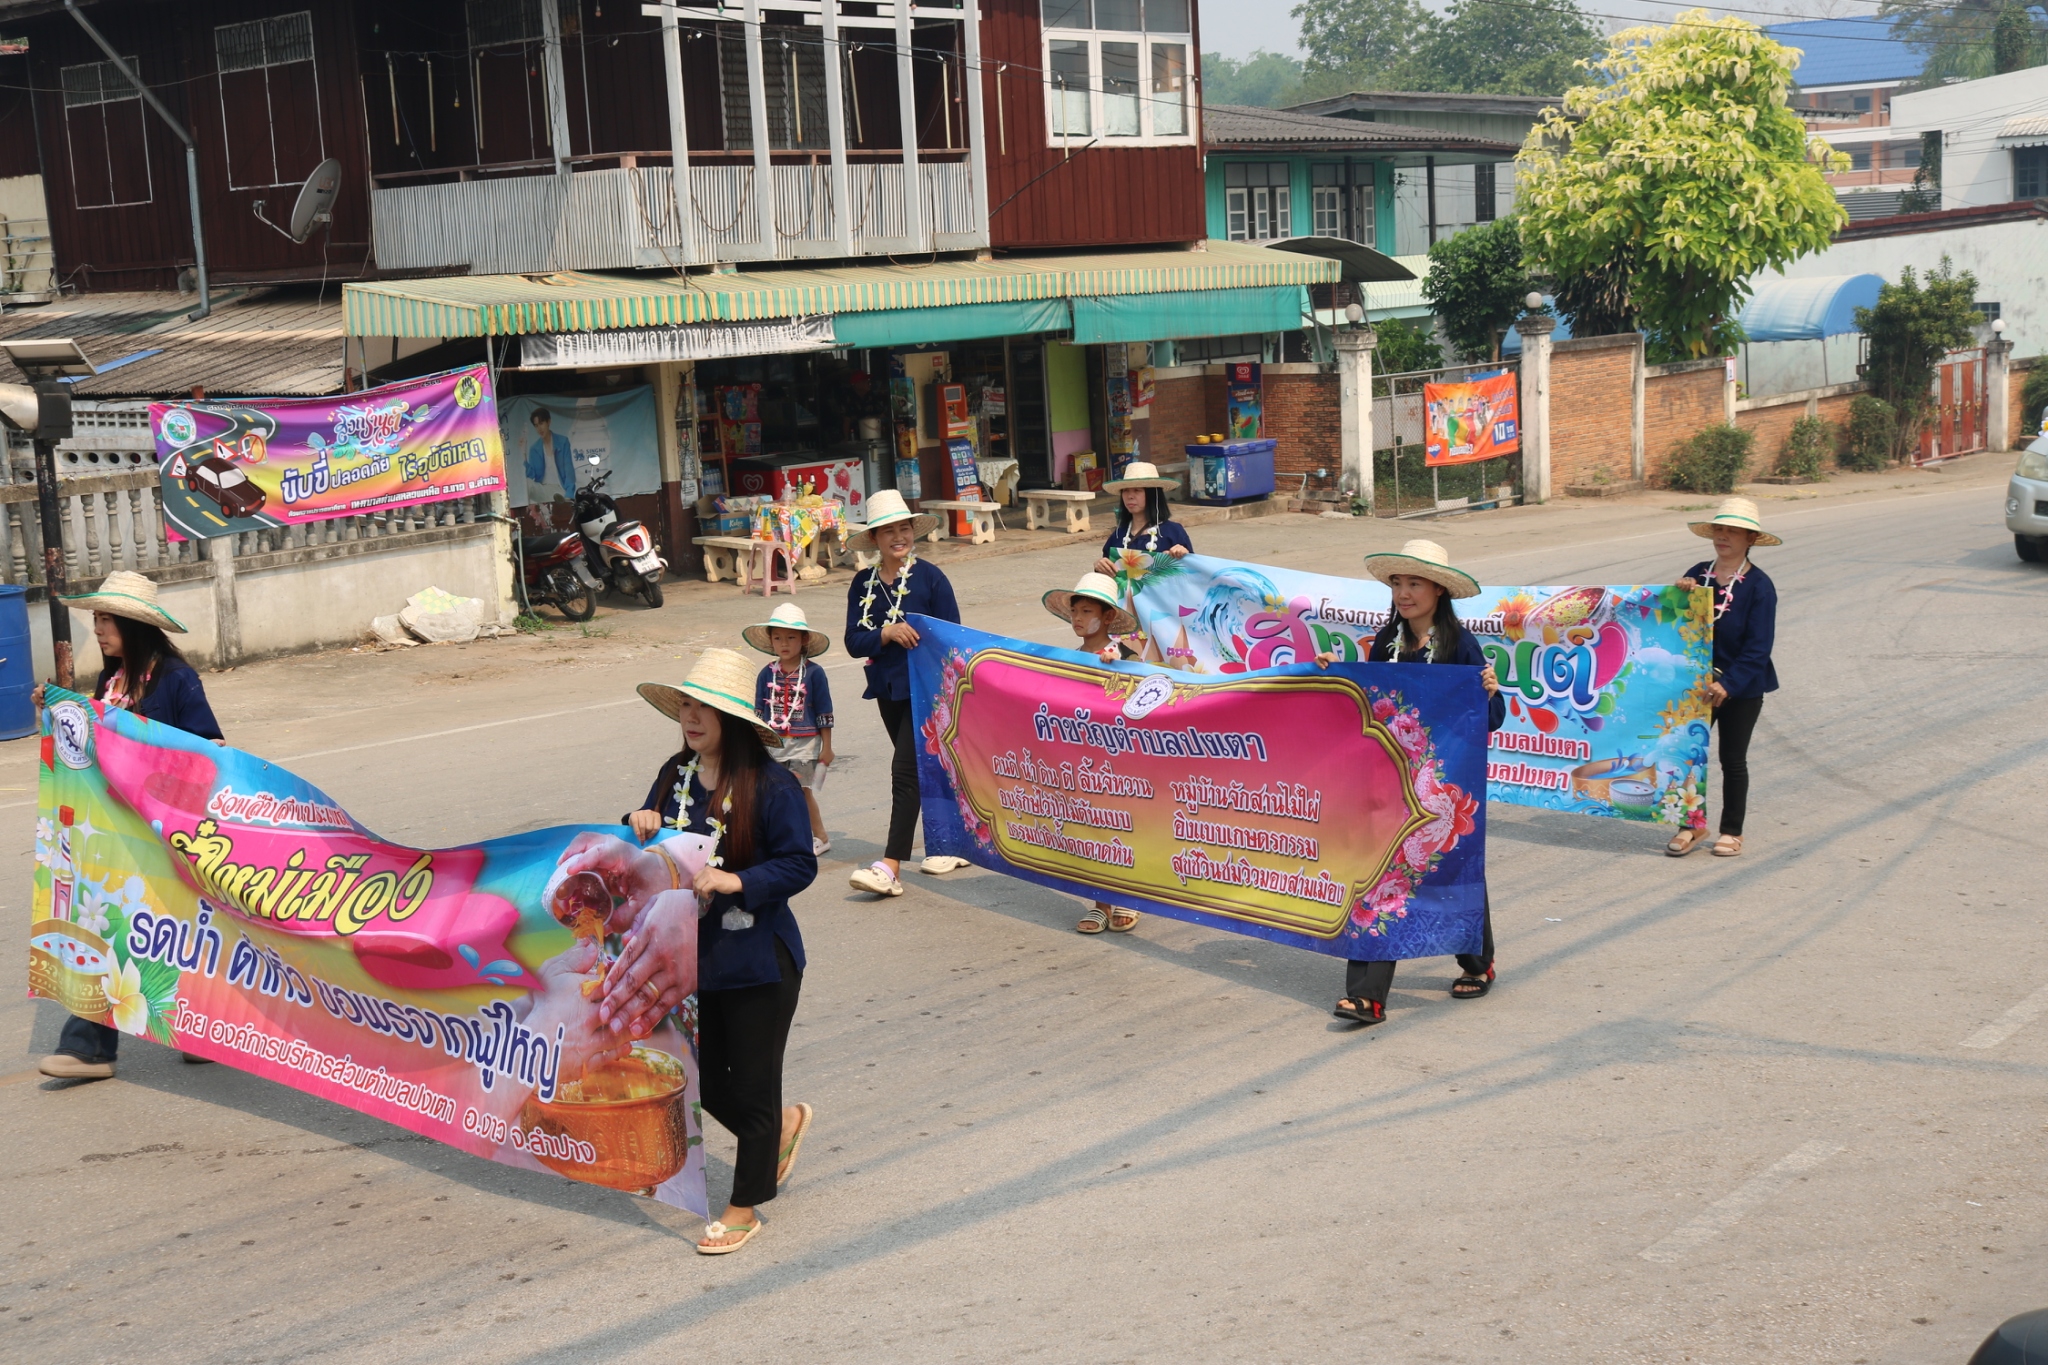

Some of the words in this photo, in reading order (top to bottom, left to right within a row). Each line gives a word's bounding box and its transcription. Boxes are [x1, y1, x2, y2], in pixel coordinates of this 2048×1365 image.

[334, 402, 409, 447] สงกรานต์
[281, 447, 330, 503] ขับขี่
[331, 455, 390, 489] ปลอดภัย
[399, 437, 487, 484] ไร้อุบัติเหตุ
[1034, 704, 1267, 760] คำขวัญตำบลปงเตา
[992, 752, 1019, 778] คนดี
[1020, 748, 1038, 782] น้ำ
[1038, 759, 1059, 787] ดิน
[1060, 761, 1075, 790] ดี
[1078, 756, 1153, 797] ลิ้นจี่หวาน
[1170, 775, 1321, 822] หมู่บ้านจักสานไม้ไผ่
[129, 899, 220, 975] รดน้ำ
[311, 976, 564, 1099] ขอพรจากผู้ใหญ่
[176, 1001, 206, 1035] โดย
[211, 1024, 455, 1123] องค์การบริหารส่วนตำบลปงเตา
[464, 1109, 506, 1145] อ.งาว
[511, 1127, 595, 1163] จ.ลำปาง
